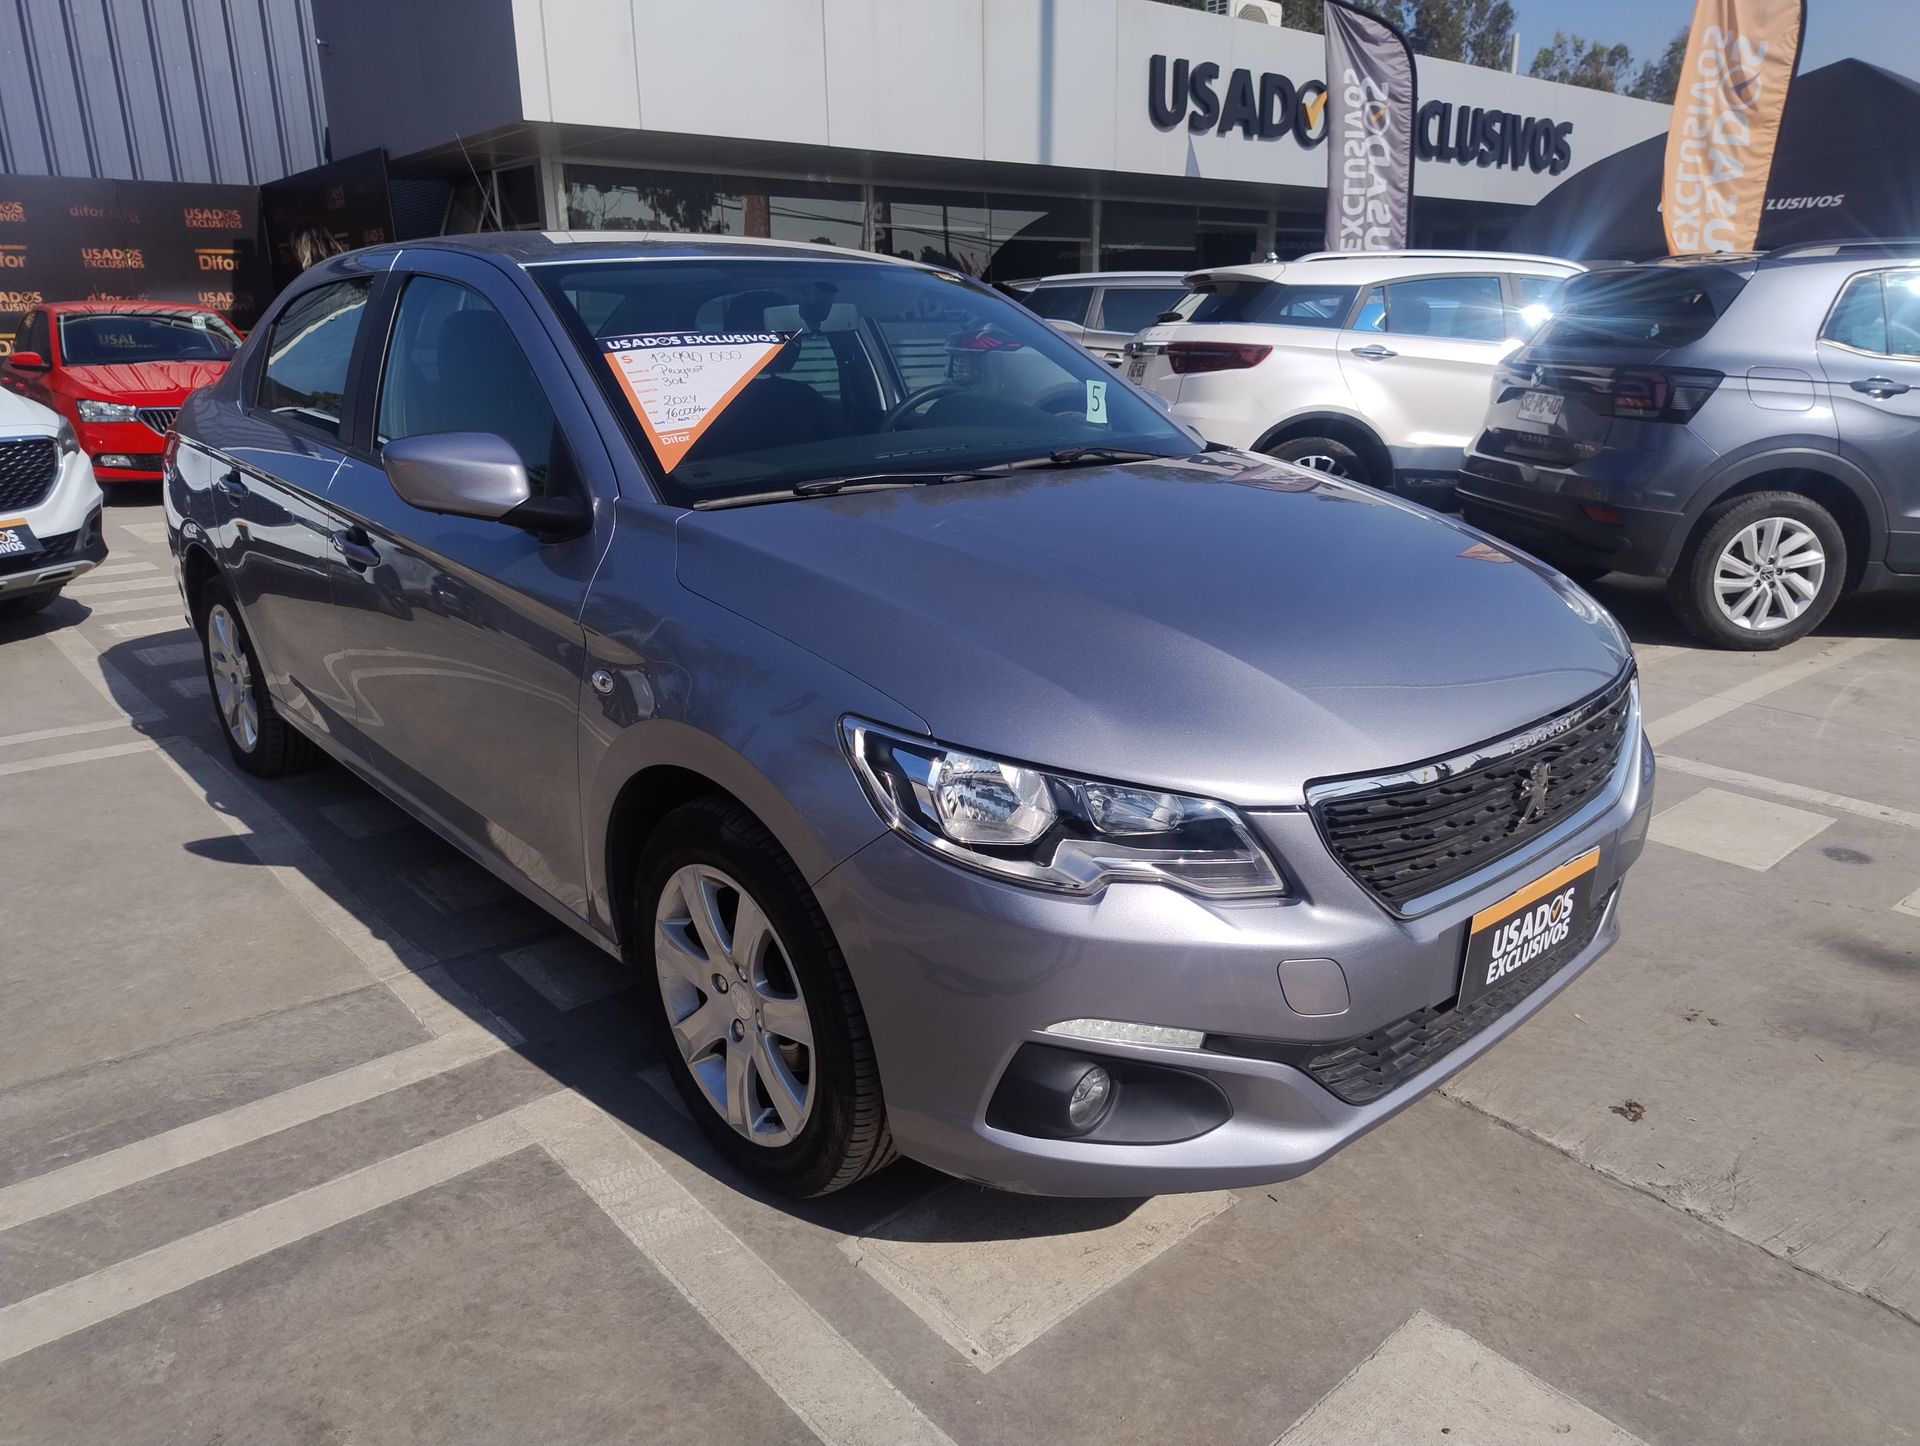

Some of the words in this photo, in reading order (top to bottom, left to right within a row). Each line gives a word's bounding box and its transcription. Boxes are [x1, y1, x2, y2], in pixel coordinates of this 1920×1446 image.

[1148, 54, 1328, 149] USADO
[1417, 99, 1573, 175] CLUSIVOS
[1766, 193, 1846, 210] LUSIVOS
[184, 208, 240, 220] USADOS
[186, 219, 242, 228] EXCLUSIVOS
[0, 251, 26, 268] for
[82, 248, 142, 260] USADOS
[84, 258, 144, 268] EXCLUSIVOS
[0, 291, 42, 303] ADOS
[607, 336, 681, 350] USADOS
[685, 334, 780, 345] EXCLUSIVOS
[663, 394, 697, 406] 2024
[1091, 385, 1101, 412] 5
[661, 433, 691, 446] Difor
[1491, 887, 1575, 959] USADOS
[1486, 917, 1571, 985] EXCLUSIVOS
